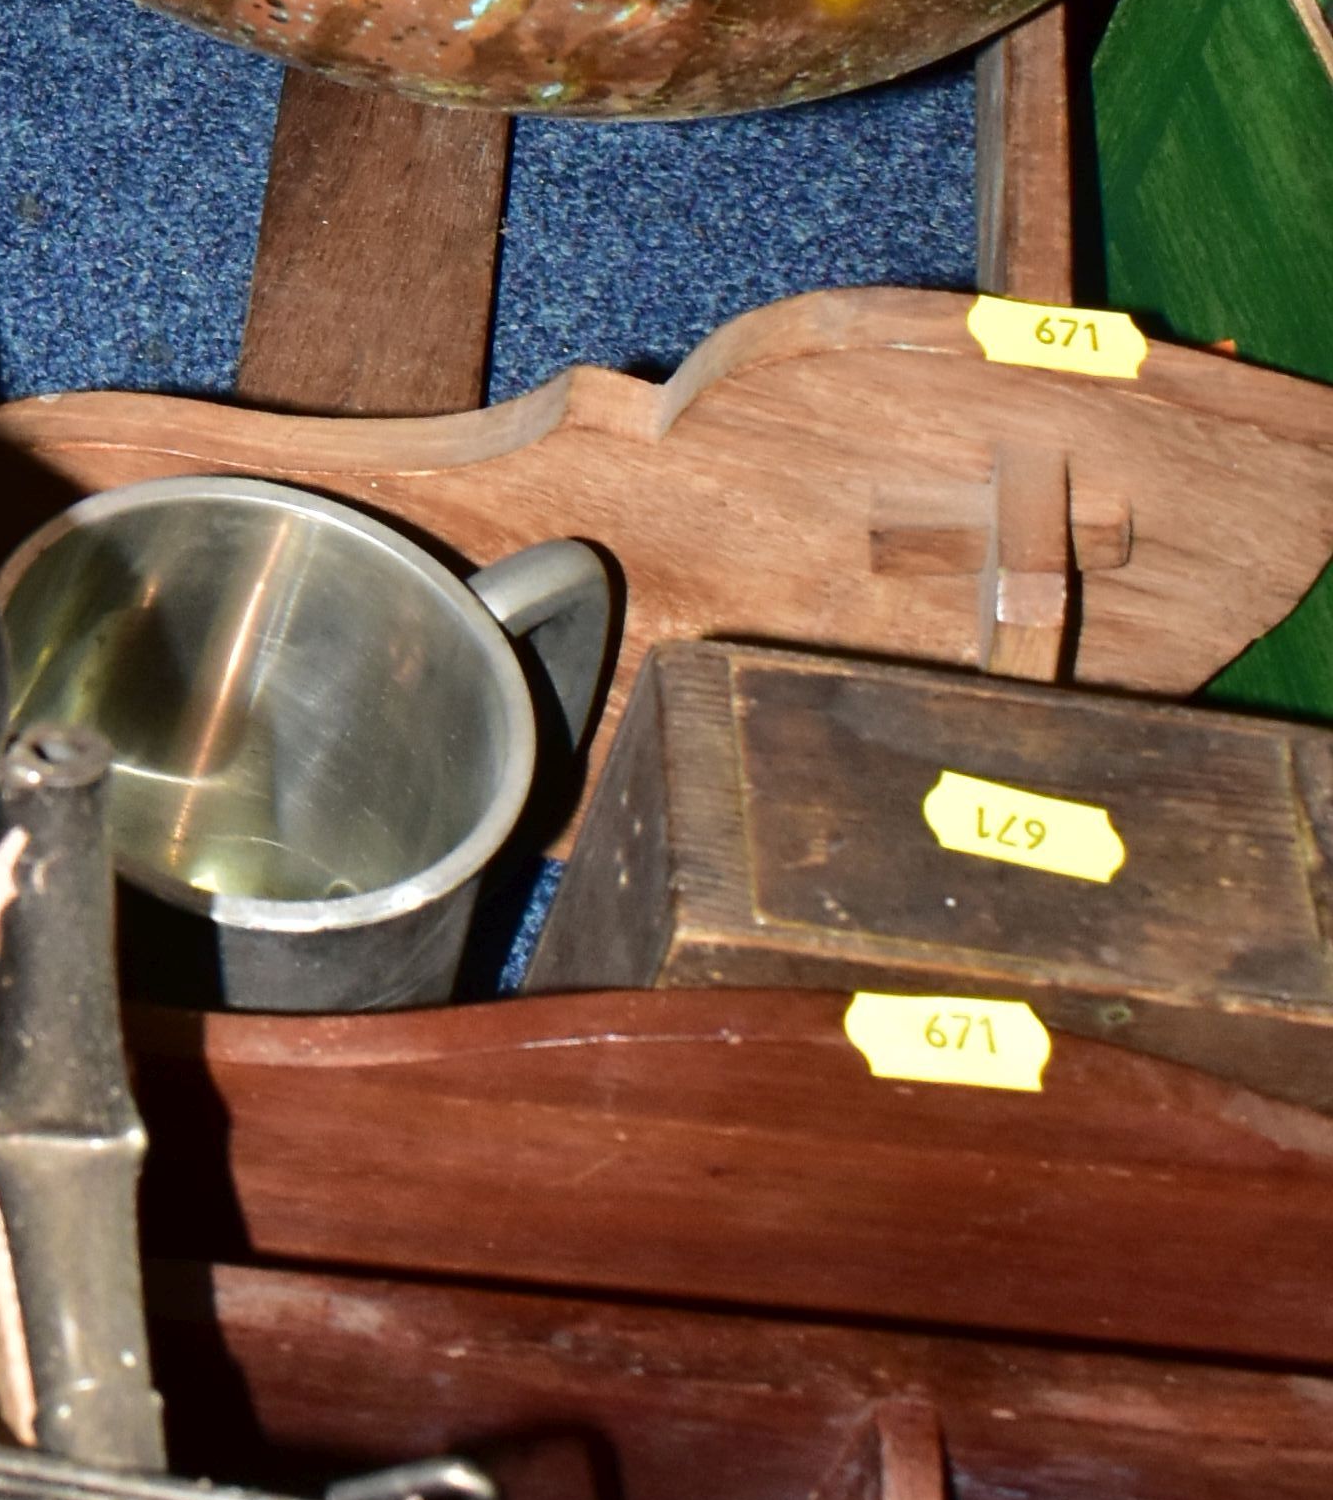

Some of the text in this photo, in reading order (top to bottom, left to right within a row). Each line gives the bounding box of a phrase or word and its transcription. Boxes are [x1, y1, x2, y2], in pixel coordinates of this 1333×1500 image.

[1034, 316, 1098, 352] 671
[975, 805, 1046, 850] 671
[924, 1013, 998, 1056] 671
